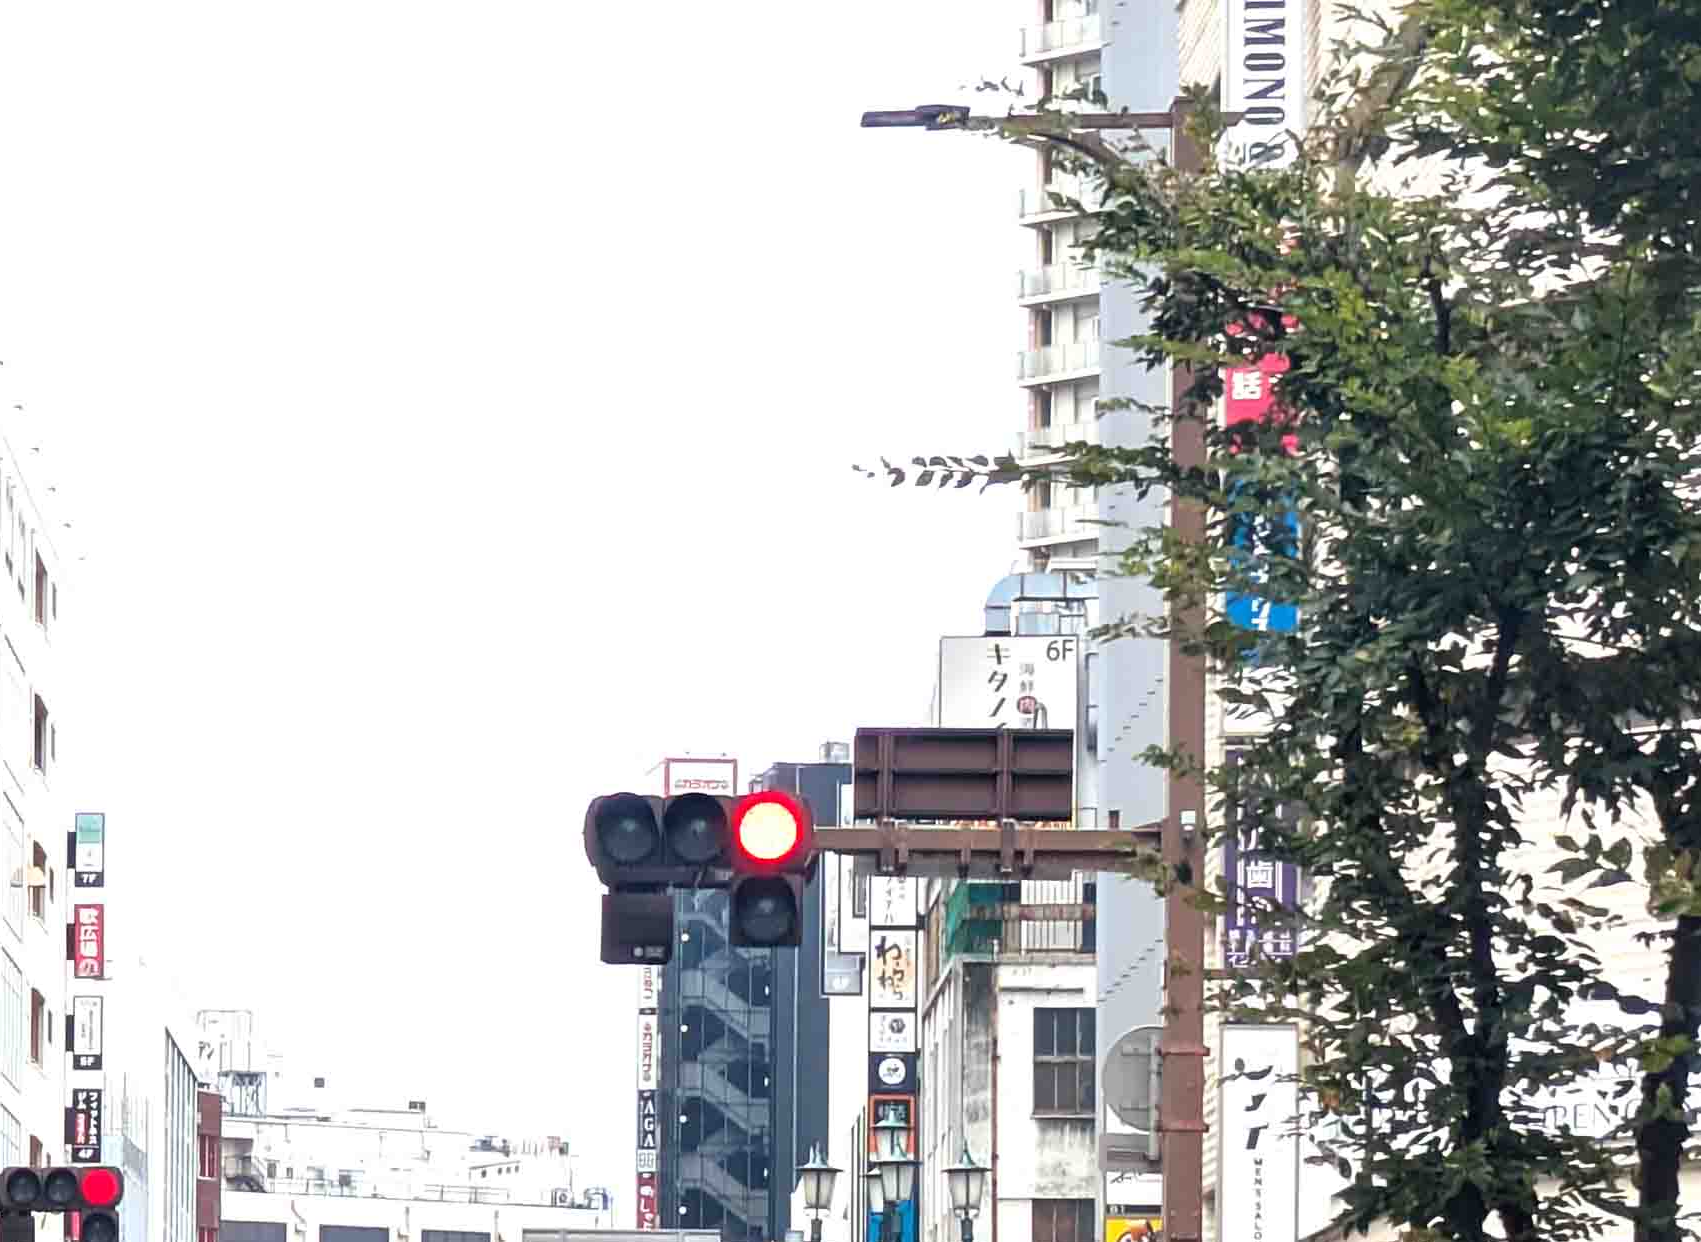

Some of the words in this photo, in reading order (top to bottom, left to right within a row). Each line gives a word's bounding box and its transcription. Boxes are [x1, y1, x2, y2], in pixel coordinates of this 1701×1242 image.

[1046, 640, 1074, 662] 6F
[987, 643, 1012, 728] キタノ
[644, 1100, 655, 1147] AGA
